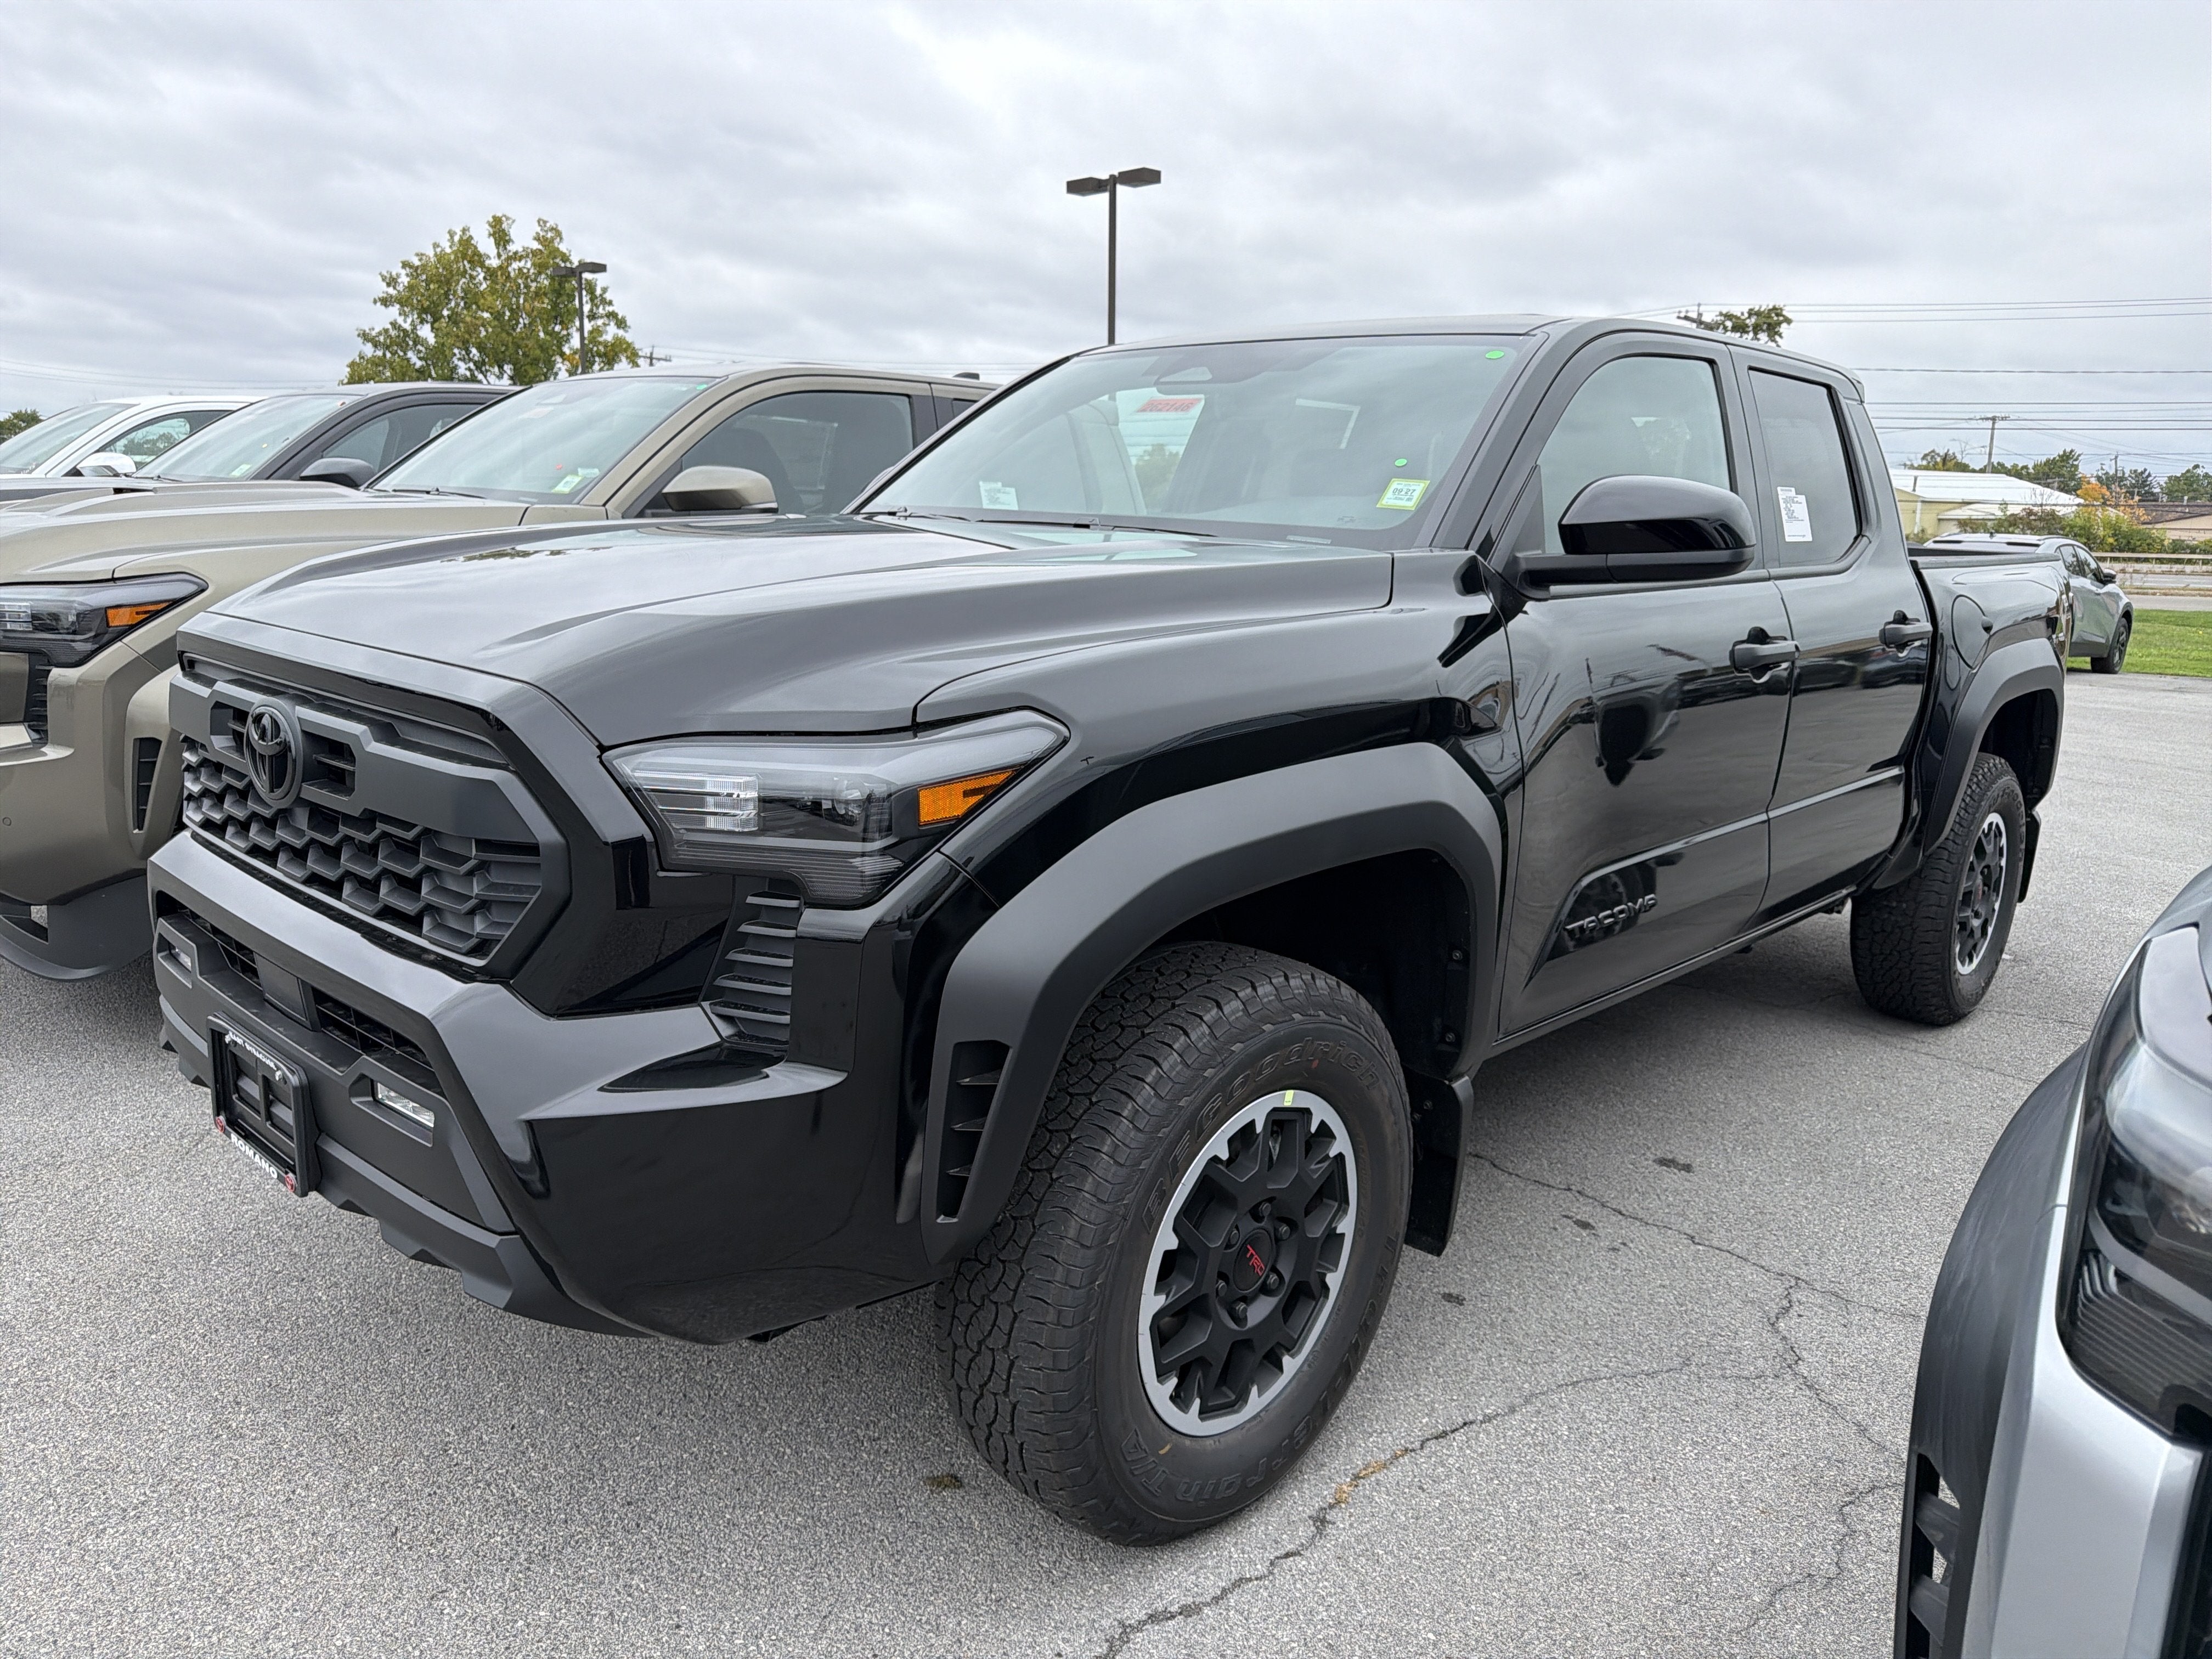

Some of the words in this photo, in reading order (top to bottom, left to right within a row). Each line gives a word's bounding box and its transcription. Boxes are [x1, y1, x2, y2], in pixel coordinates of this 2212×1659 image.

[1564, 893, 1658, 939] TACOMA
[230, 1133, 278, 1179] ROMANO
[1142, 1037, 1381, 1234] BFGoodrich
[1246, 1244, 1265, 1277] TRD
[1120, 1426, 1170, 1497] T/A
